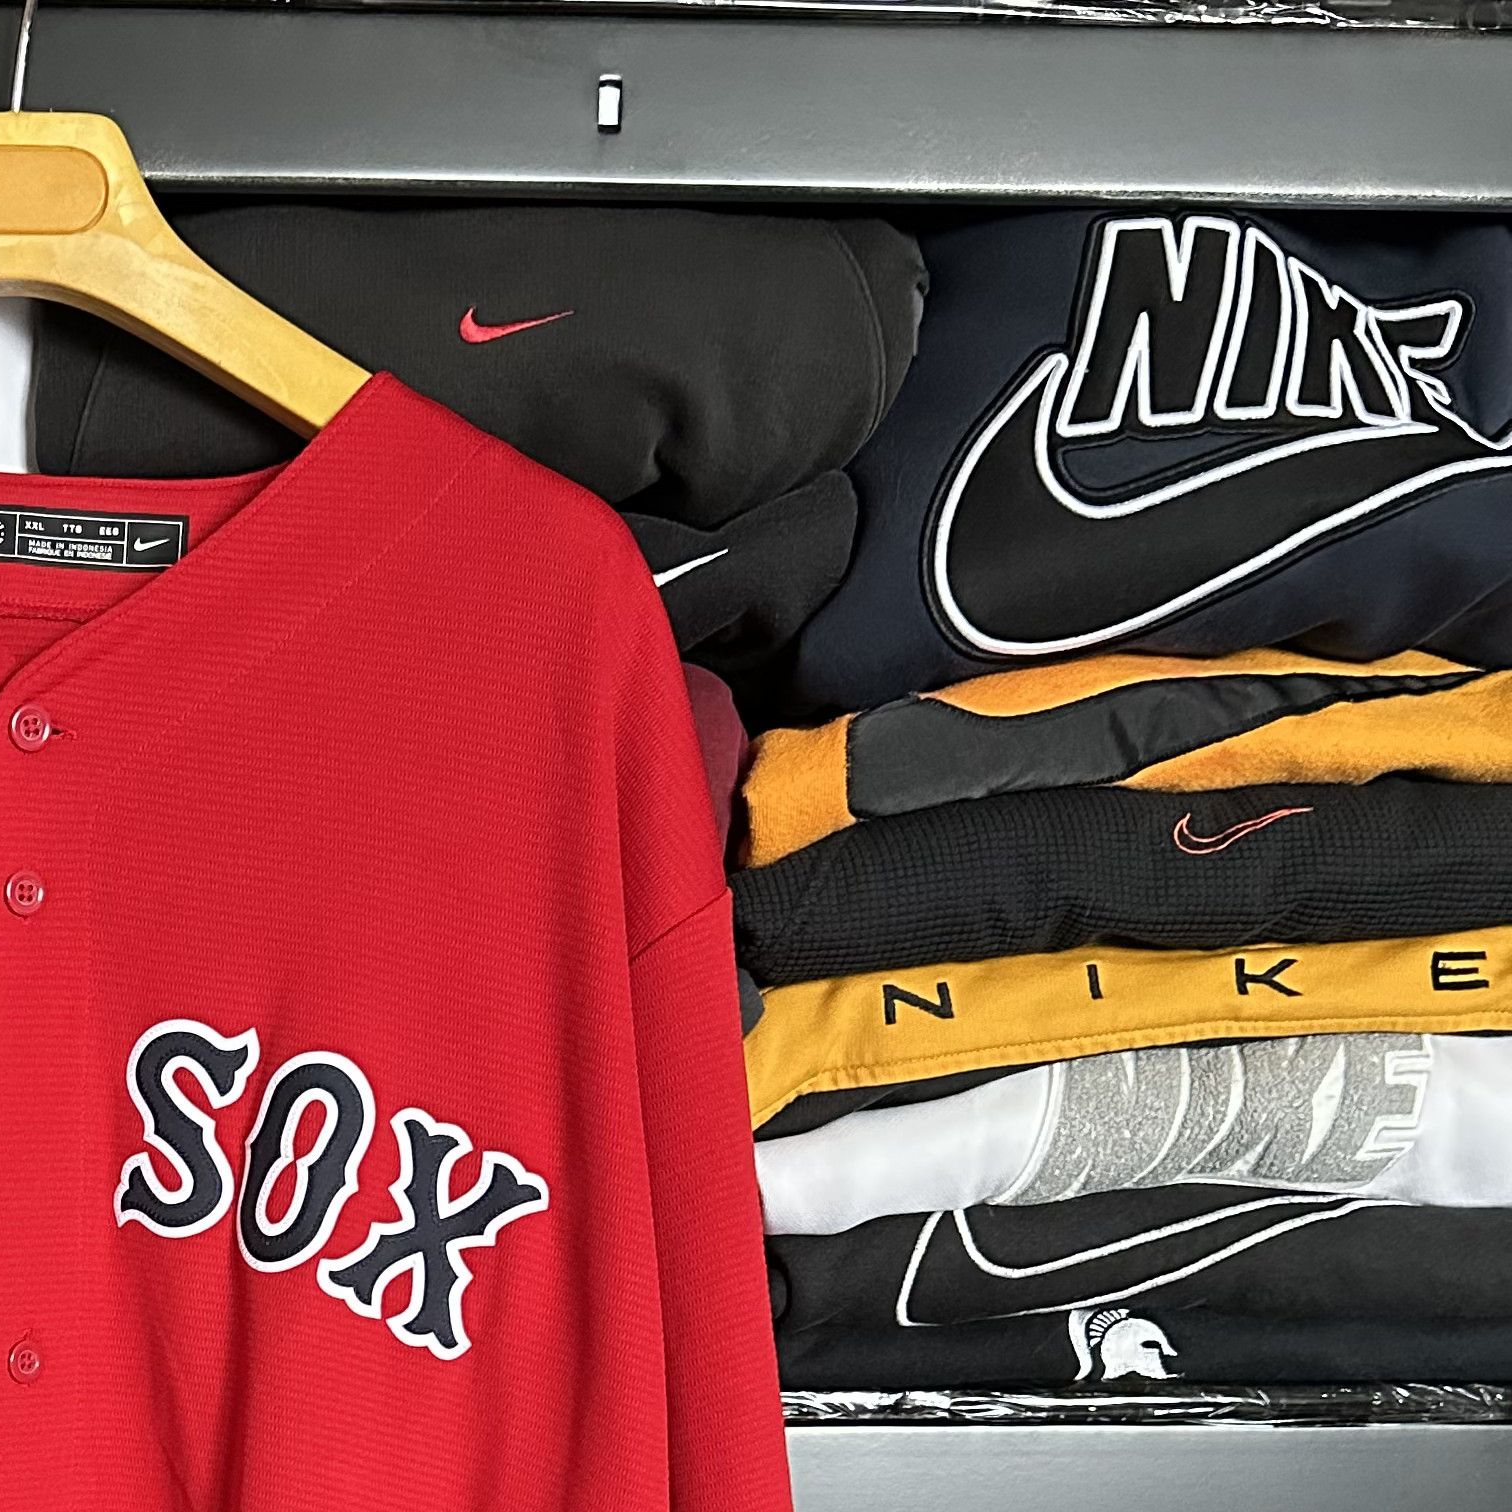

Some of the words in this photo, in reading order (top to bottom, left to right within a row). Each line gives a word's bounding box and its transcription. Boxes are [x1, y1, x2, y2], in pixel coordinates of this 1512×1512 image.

[1057, 216, 1463, 438] NIKE
[25, 521, 44, 532] XXL
[28, 540, 51, 549] MADE
[56, 542, 65, 550] IN
[68, 543, 113, 553] INDONESIA
[883, 951, 1487, 1025] NIKE
[113, 1018, 549, 1361] SOX
